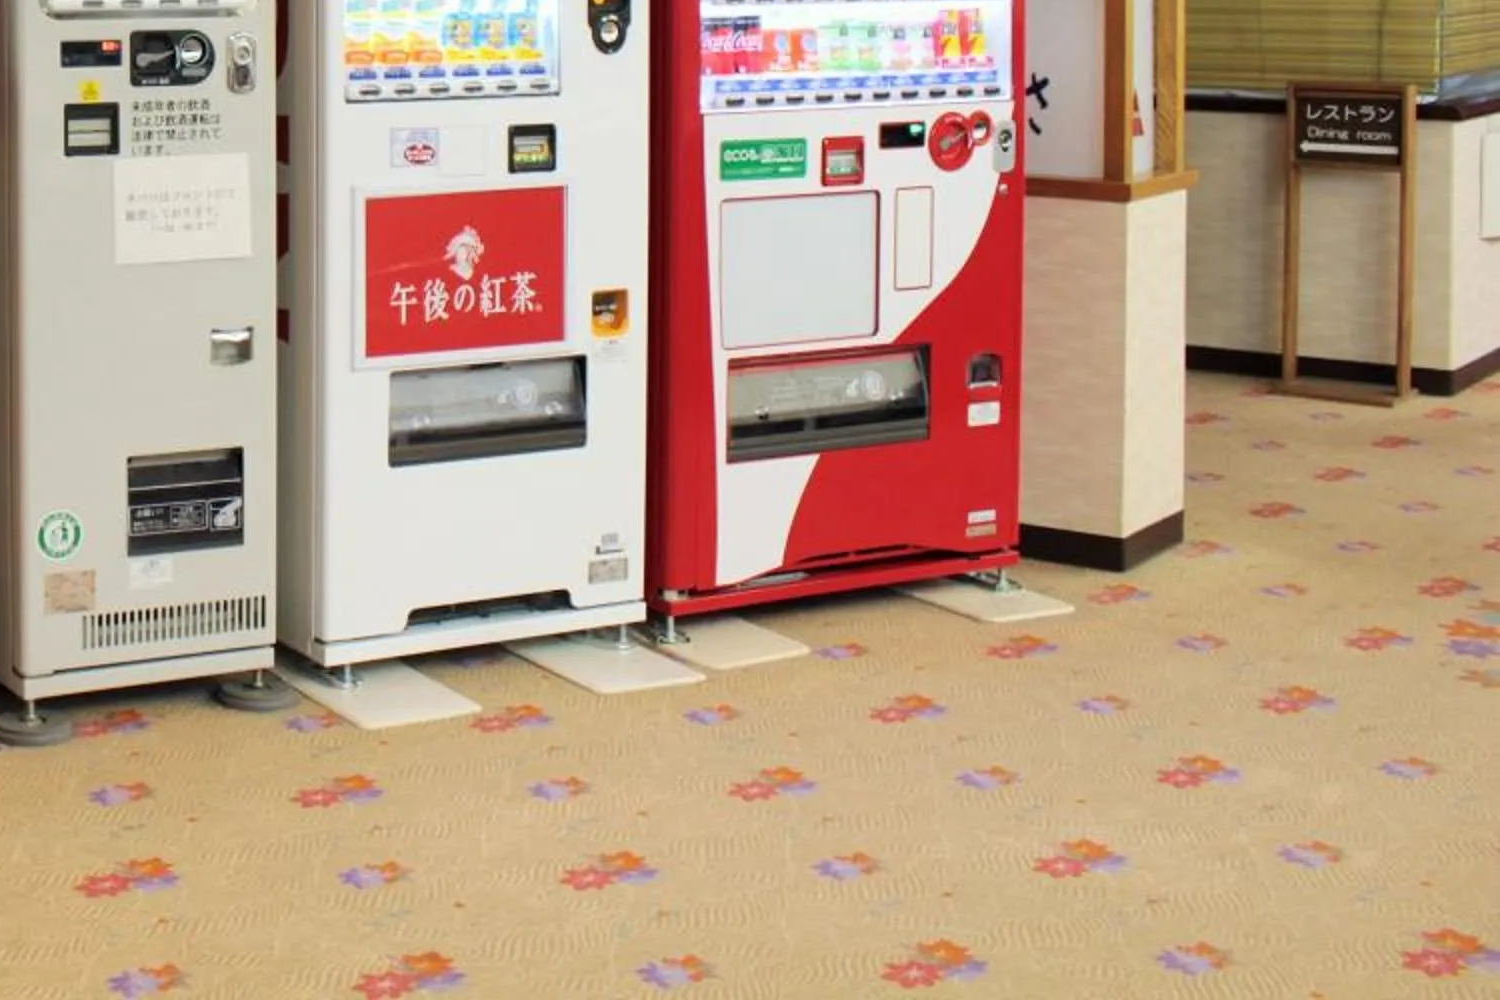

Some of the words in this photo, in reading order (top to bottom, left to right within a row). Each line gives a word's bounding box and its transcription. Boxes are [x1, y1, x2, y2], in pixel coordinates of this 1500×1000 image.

[1306, 103, 1396, 122] レストラン
[1307, 124, 1349, 140] Dining
[1356, 129, 1392, 141] room
[389, 271, 538, 326] 午後の紅茶
